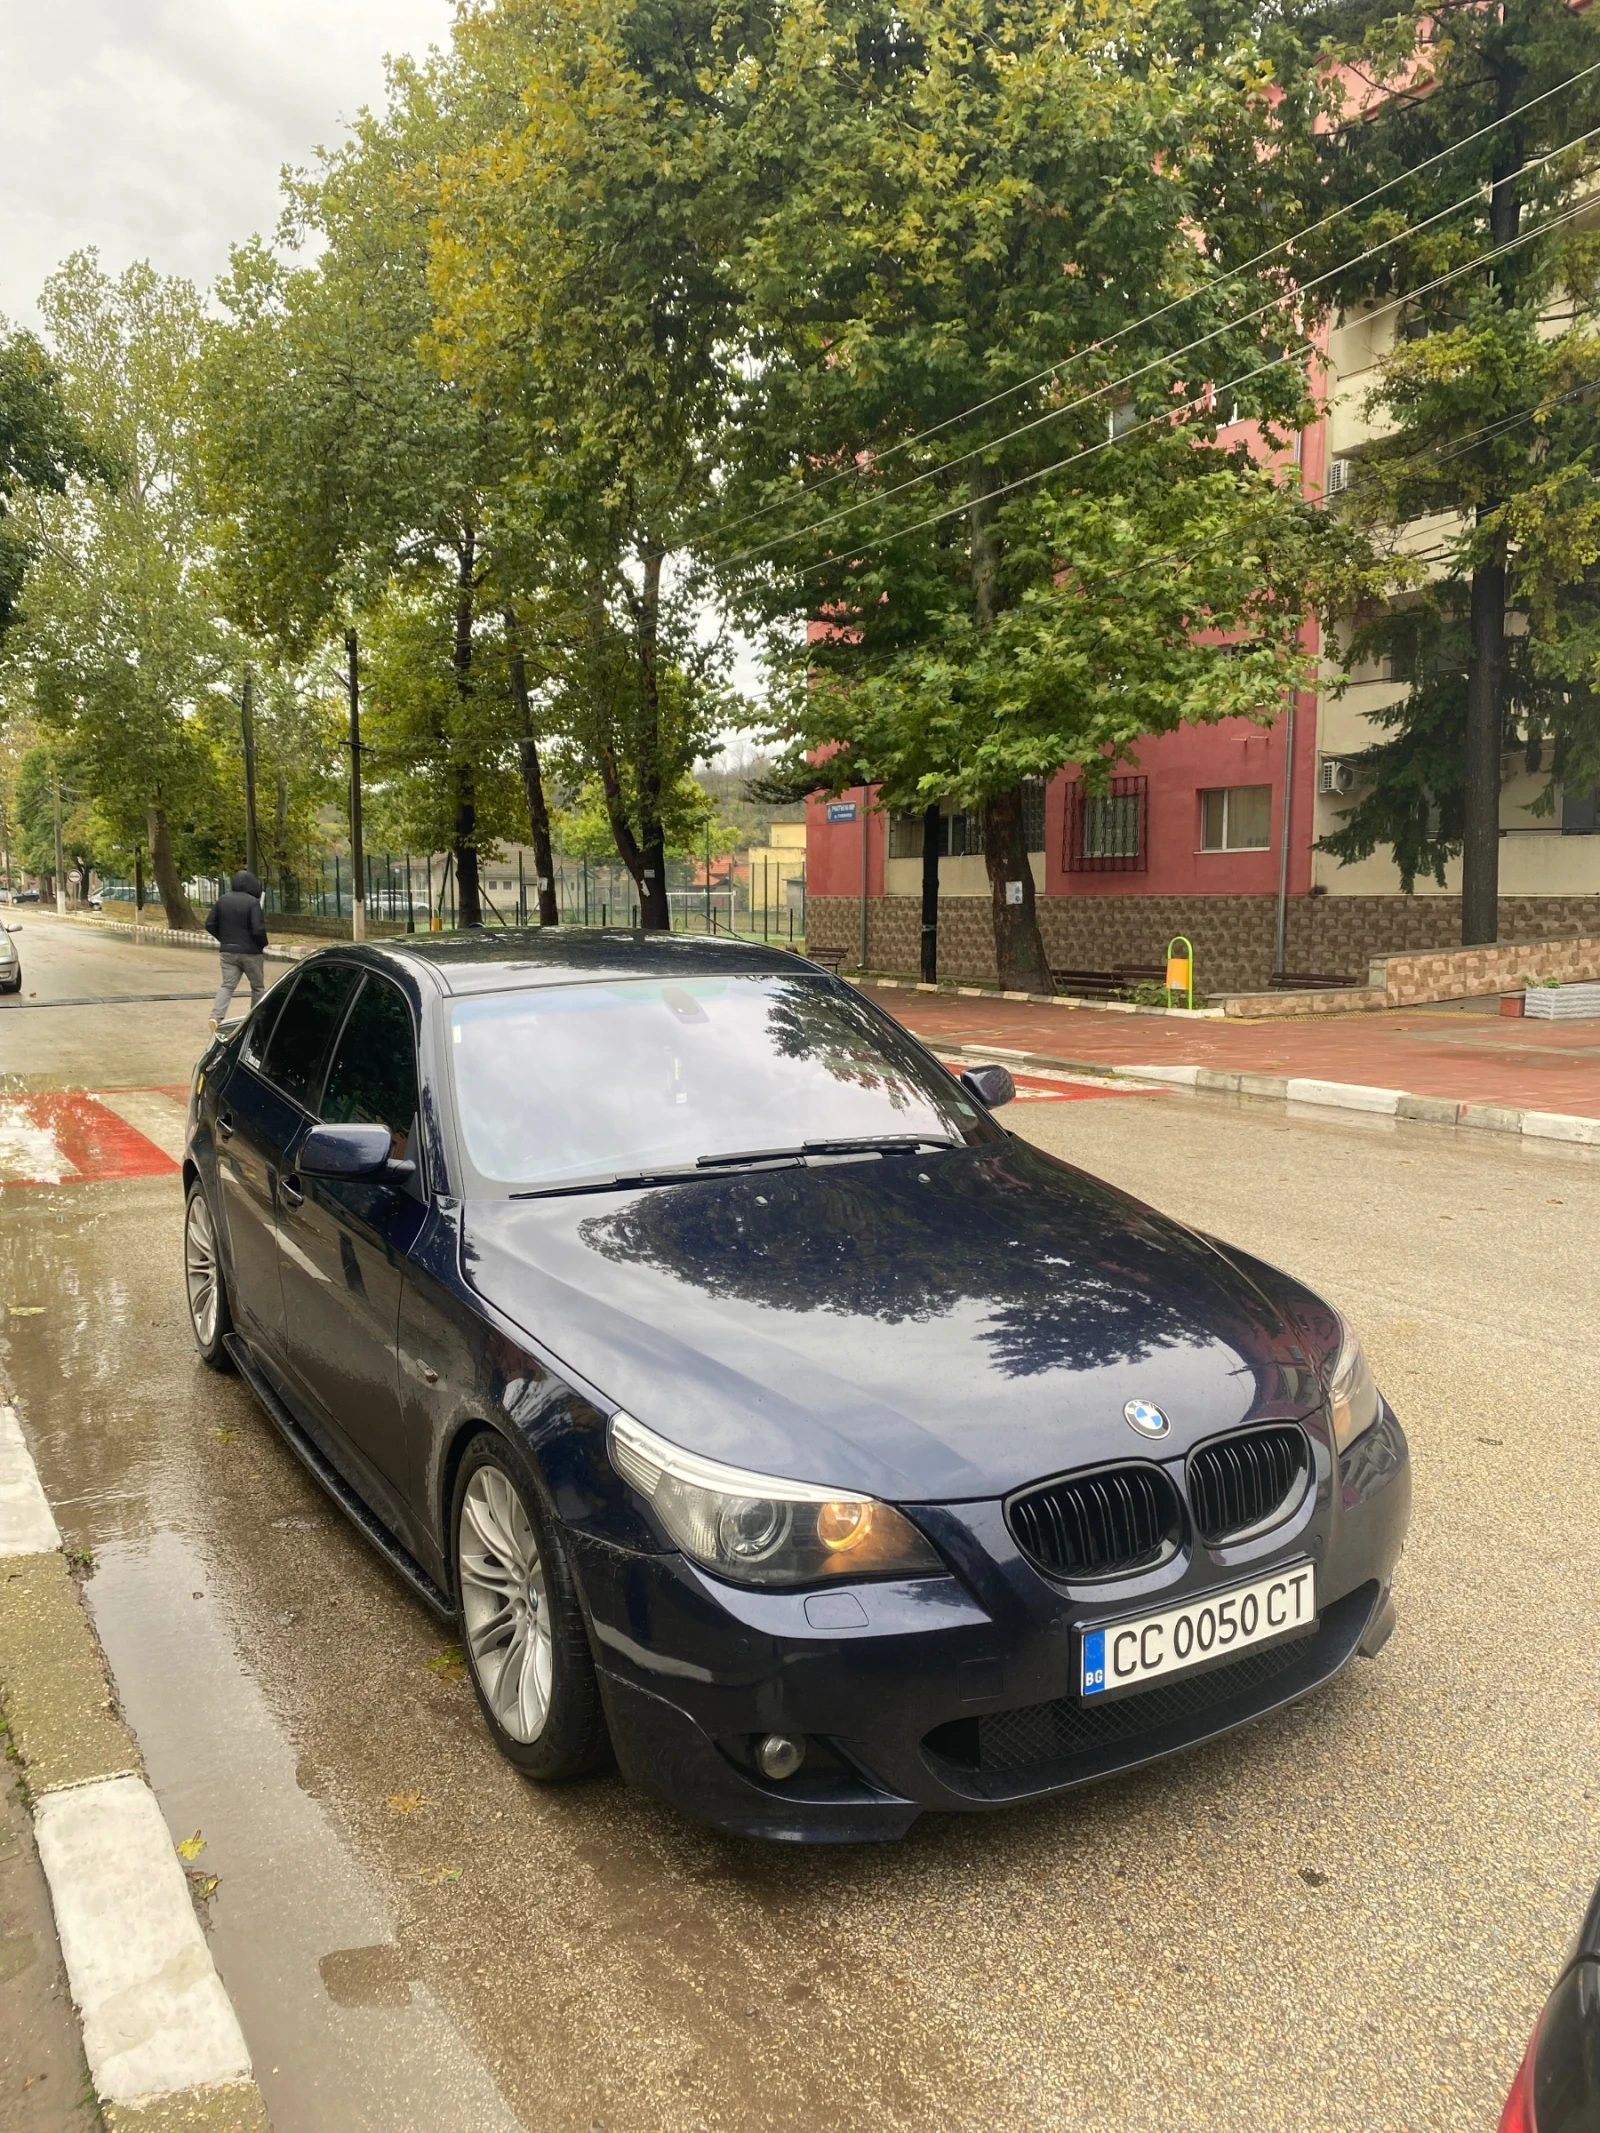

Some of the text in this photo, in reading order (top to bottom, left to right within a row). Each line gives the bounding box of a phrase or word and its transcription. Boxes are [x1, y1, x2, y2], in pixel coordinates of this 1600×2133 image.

[1113, 1573, 1308, 1677] CC 0050 CT
[1085, 1669, 1103, 1687] BG
